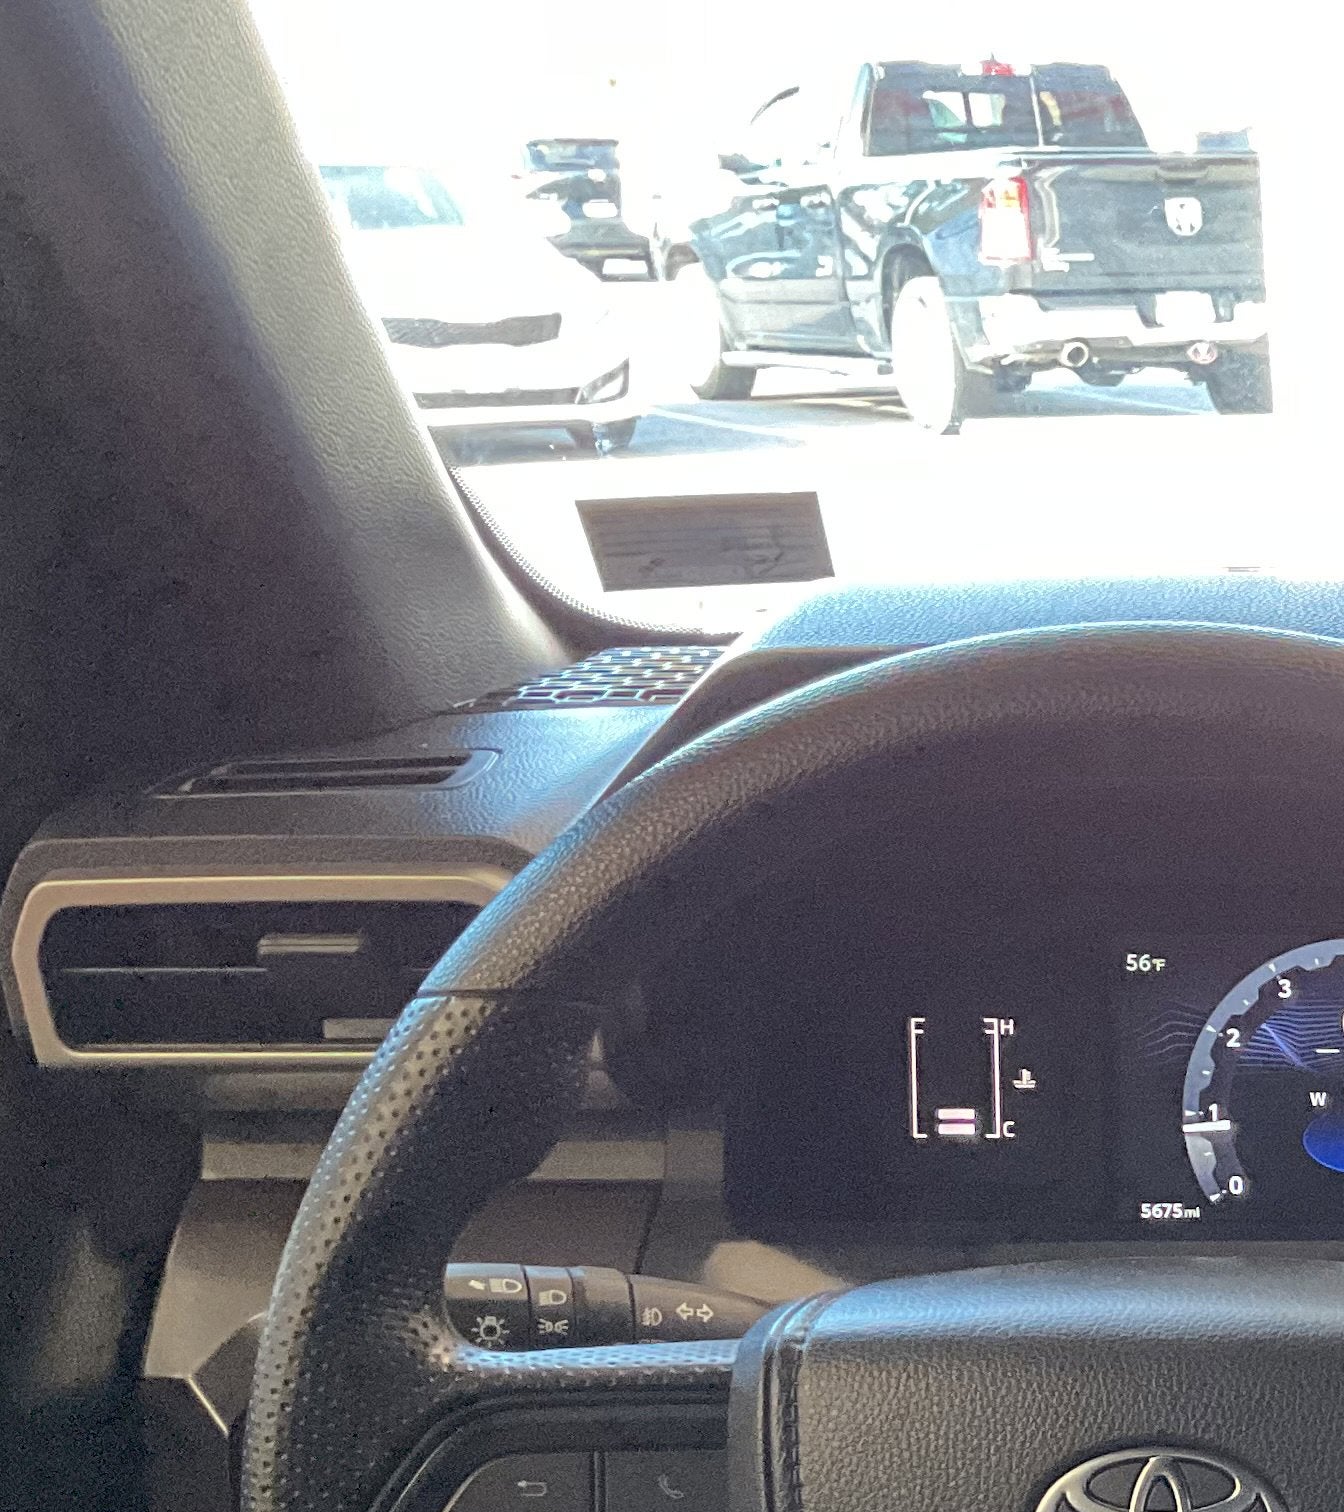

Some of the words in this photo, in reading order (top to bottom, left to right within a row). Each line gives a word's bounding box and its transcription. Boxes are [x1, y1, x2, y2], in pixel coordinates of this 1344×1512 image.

[1277, 979, 1292, 998] 3
[1000, 1019, 1014, 1036] H
[1226, 1029, 1241, 1047] 2
[1309, 1093, 1327, 1107] W
[1208, 1104, 1218, 1121] 1
[1002, 1121, 1015, 1137] C
[1229, 1176, 1243, 1194] 0
